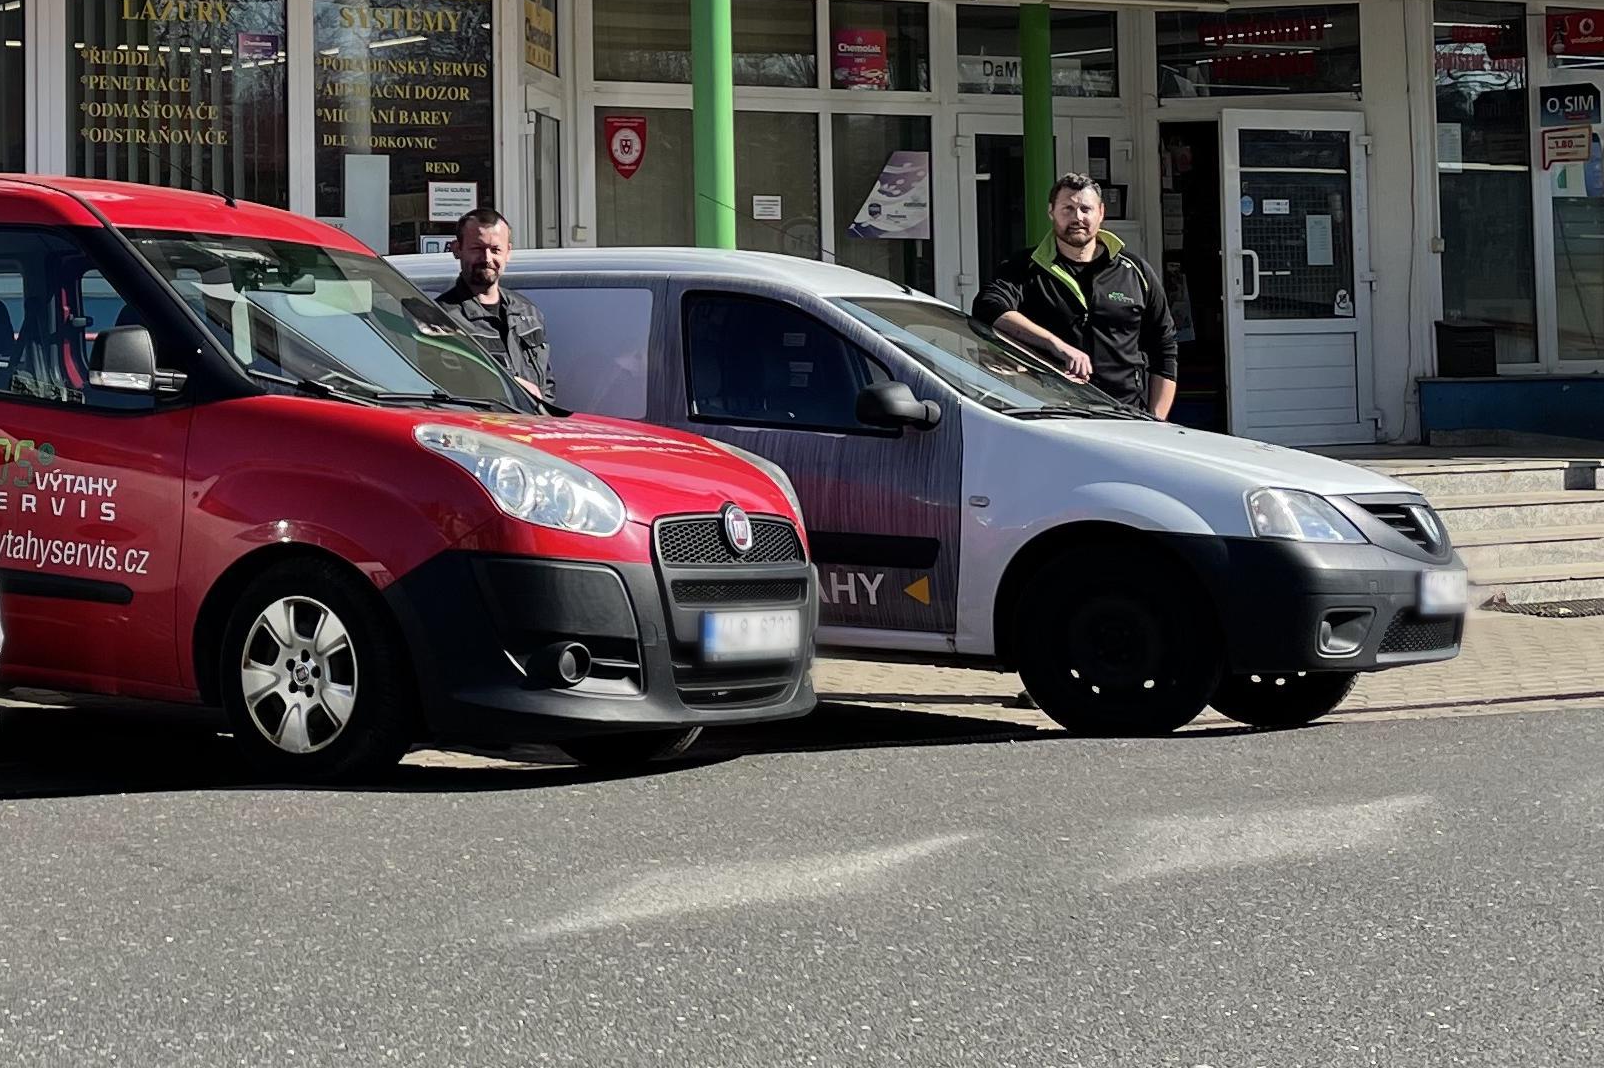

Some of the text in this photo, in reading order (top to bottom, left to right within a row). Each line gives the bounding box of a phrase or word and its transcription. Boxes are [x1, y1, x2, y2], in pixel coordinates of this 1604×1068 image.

[433, 61, 488, 78] SERVIS
[88, 75, 192, 93] PENETRACE
[415, 85, 471, 101] DOZOR
[88, 99, 220, 120] ODMAŠŤOVAČE
[1564, 95, 1595, 113] SIM
[399, 109, 452, 125] BAREV
[88, 125, 228, 145] ODSTRAŇOVAČE
[425, 161, 461, 174] REND
[34, 468, 118, 498] VÝTAHY
